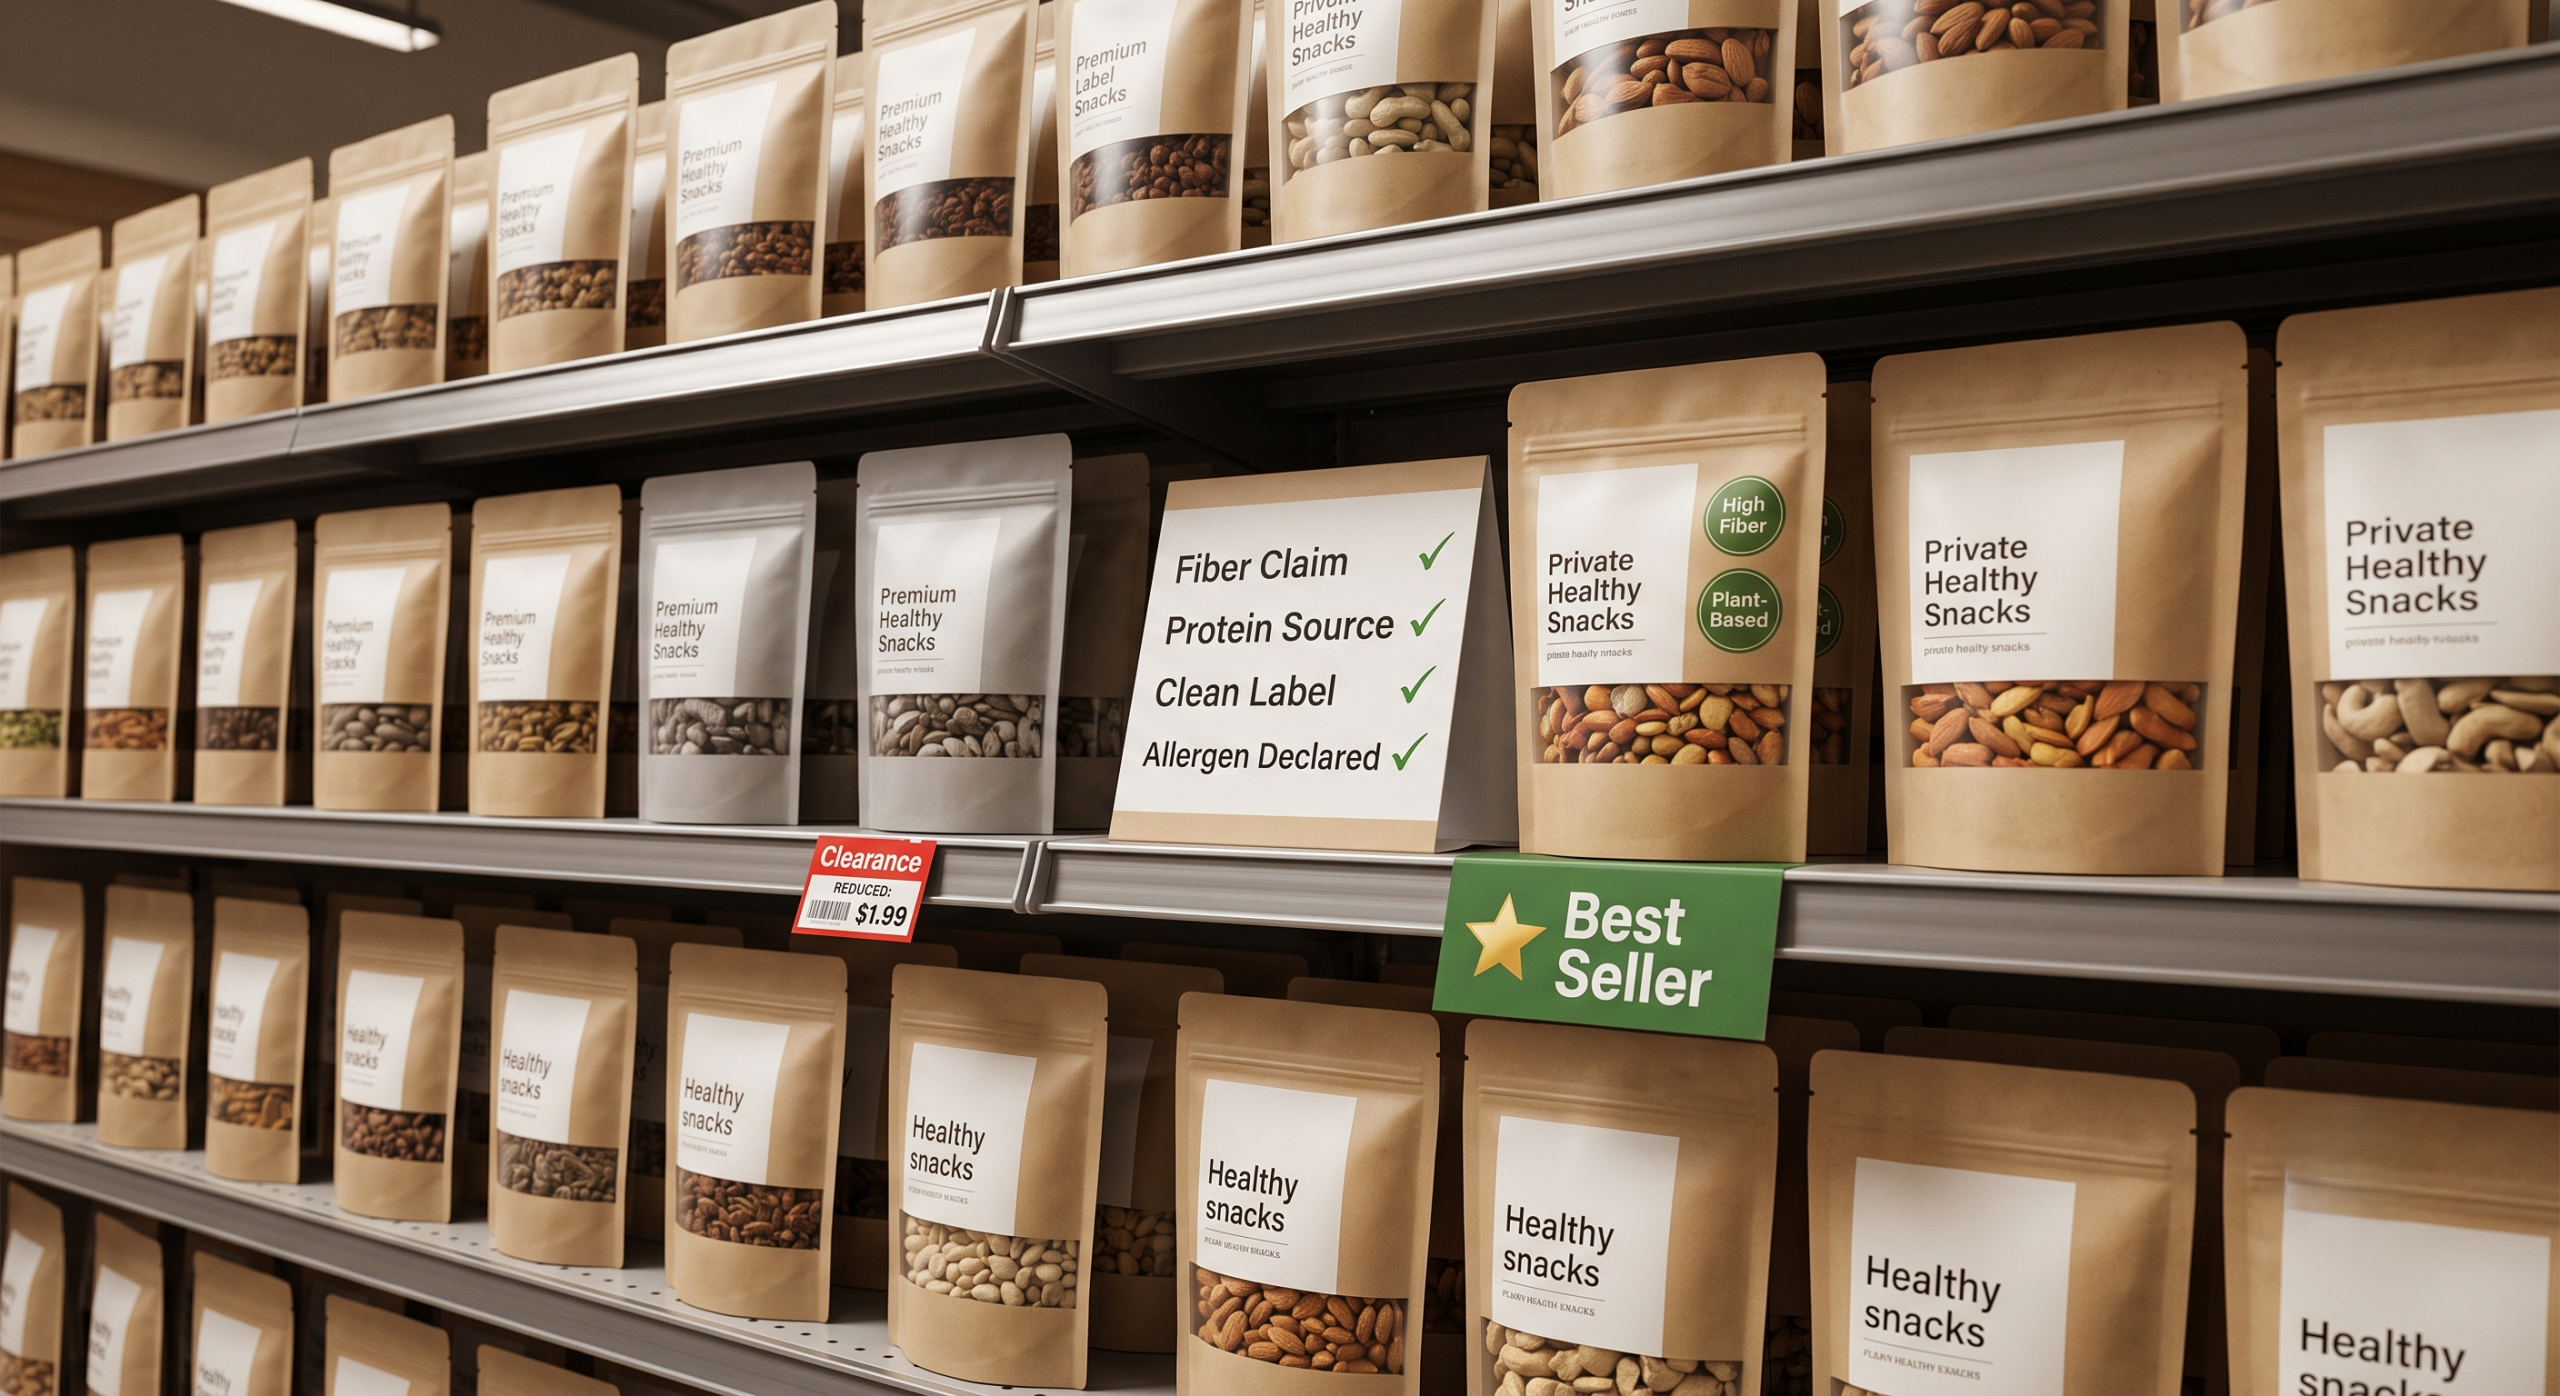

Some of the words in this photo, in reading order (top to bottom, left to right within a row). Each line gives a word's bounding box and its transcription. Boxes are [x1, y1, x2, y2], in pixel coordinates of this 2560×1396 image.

[1292, 10, 1363, 43] Healthy
[1076, 40, 1147, 74] Premium
[1292, 34, 1356, 66] Snacks
[1075, 65, 1115, 95] Label
[881, 91, 942, 121] Premium
[1074, 87, 1127, 117] Snacks
[880, 111, 929, 141] Healthy
[682, 139, 742, 166] Premium
[878, 134, 922, 162] Snacks
[681, 158, 728, 185] Healthy
[501, 184, 554, 206] Premium
[681, 177, 723, 205] Snacks
[1722, 496, 1765, 516] High
[1719, 517, 1767, 534] Fiber
[2346, 516, 2474, 546] Private
[1548, 550, 1634, 575] Private
[1925, 536, 2027, 564] Private
[1176, 553, 1252, 584] Fiber
[1261, 547, 1348, 580] Claim
[2346, 548, 2487, 582] Healthy
[881, 585, 957, 605] Premium
[1548, 577, 1642, 606] Healthy
[1925, 565, 2038, 597] Healthy
[656, 598, 718, 617] Premium
[1712, 591, 1767, 607] Plant-
[1924, 598, 2030, 627] Snacks
[2346, 584, 2479, 616] Snacks
[485, 609, 536, 627] Premium
[655, 620, 706, 641] Healthy
[880, 608, 943, 632] Healthy
[1165, 612, 1272, 645] Protein
[1282, 611, 1394, 642] Source
[1548, 607, 1634, 633] Snacks
[1710, 612, 1768, 628] Based
[484, 629, 525, 649] Healthy
[653, 642, 699, 661] Snacks
[879, 632, 936, 653] Snacks
[1991, 642, 2030, 652] snacks
[481, 649, 518, 666] Snacks
[1156, 676, 1239, 707] Clean
[1250, 674, 1336, 706] Label
[1142, 741, 1249, 774] Allergen
[1258, 742, 1381, 770] Declared
[820, 845, 923, 874] Clearance
[833, 882, 892, 898] REDUCED:
[855, 902, 908, 927] $1.99
[1564, 891, 1686, 946] Best
[1555, 948, 1712, 1007] Seller
[503, 1048, 552, 1080] Healthy
[500, 1077, 542, 1100] snacks
[684, 1077, 745, 1114] Healthy
[683, 1110, 733, 1136] snacks
[913, 1114, 986, 1155] Healthy
[910, 1151, 974, 1180] snacks
[1208, 1158, 1299, 1205] Healthy
[1205, 1199, 1285, 1232] snacks
[1505, 1204, 1615, 1256] Healthy
[1503, 1248, 1600, 1287] snacks
[1866, 1254, 2001, 1313] Healthy
[1864, 1305, 1986, 1349] snacks
[2301, 1317, 2466, 1383] Healthy
